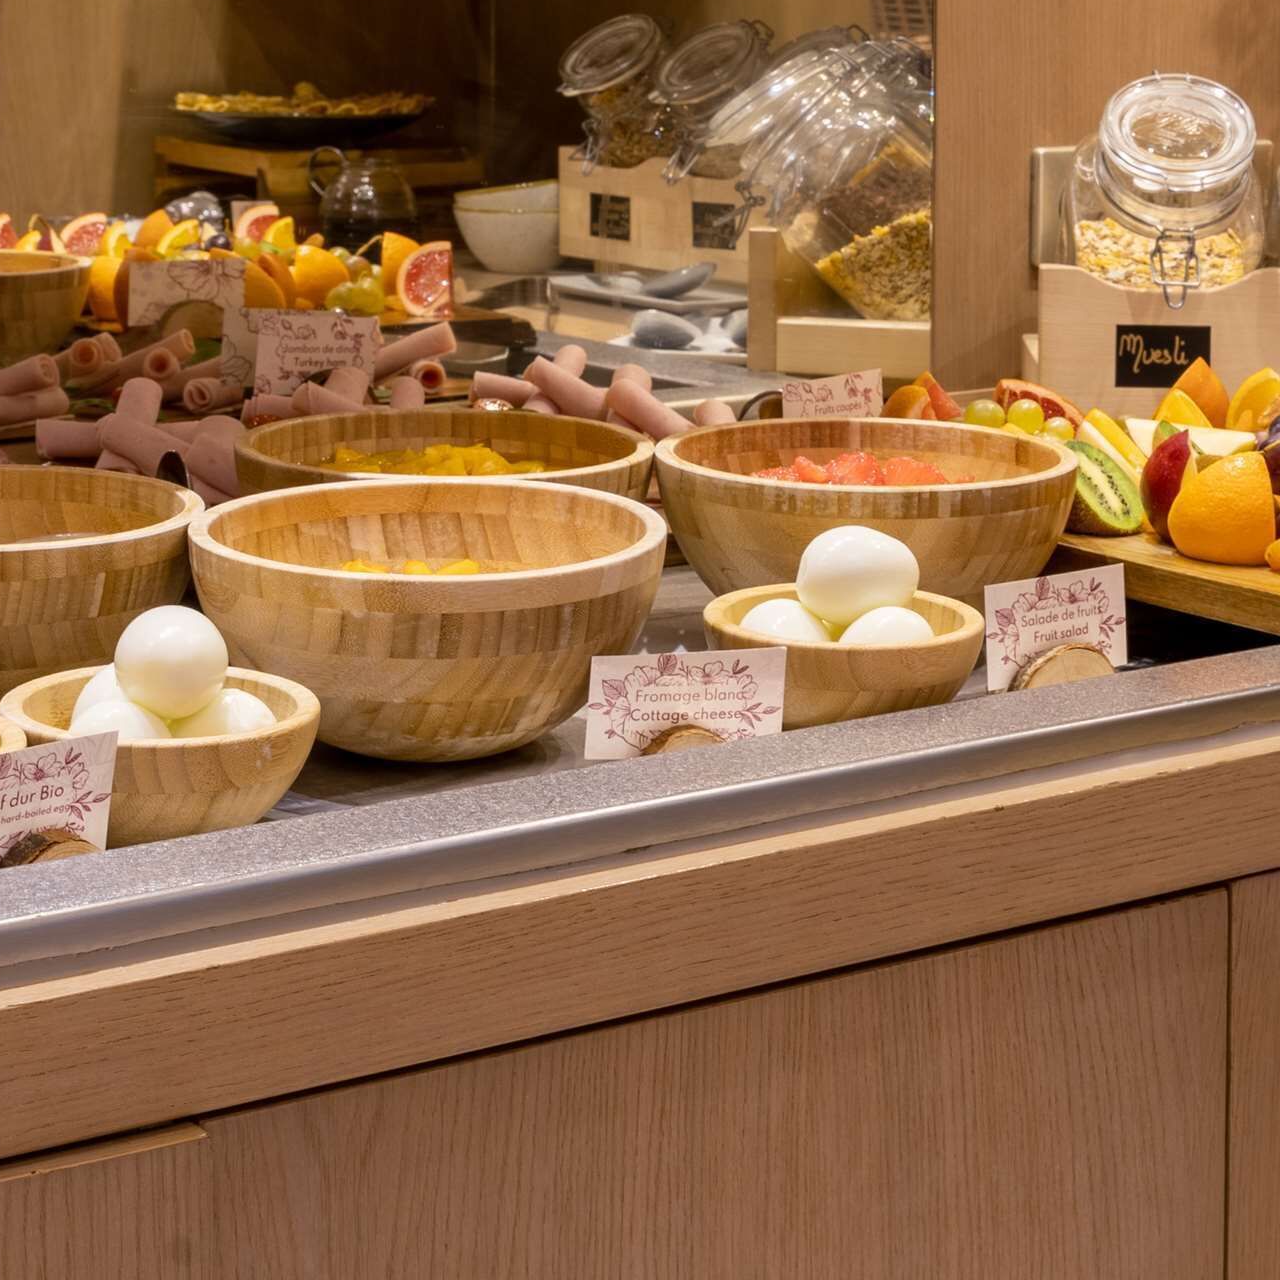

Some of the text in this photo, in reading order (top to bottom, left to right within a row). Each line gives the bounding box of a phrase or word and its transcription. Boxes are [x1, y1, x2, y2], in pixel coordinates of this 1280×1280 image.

[293, 356, 325, 369] Turkey
[1119, 333, 1189, 374] Muesli
[814, 404, 835, 415] Fruits
[1021, 605, 1102, 628] Salade de fruits
[1034, 624, 1089, 643] Fruit salad
[635, 687, 748, 704] Fromage blanc
[631, 707, 742, 724] Cottage cheese
[9, 790, 36, 807] dur
[40, 784, 64, 800] Bio
[1, 807, 52, 825] hard-boiled
